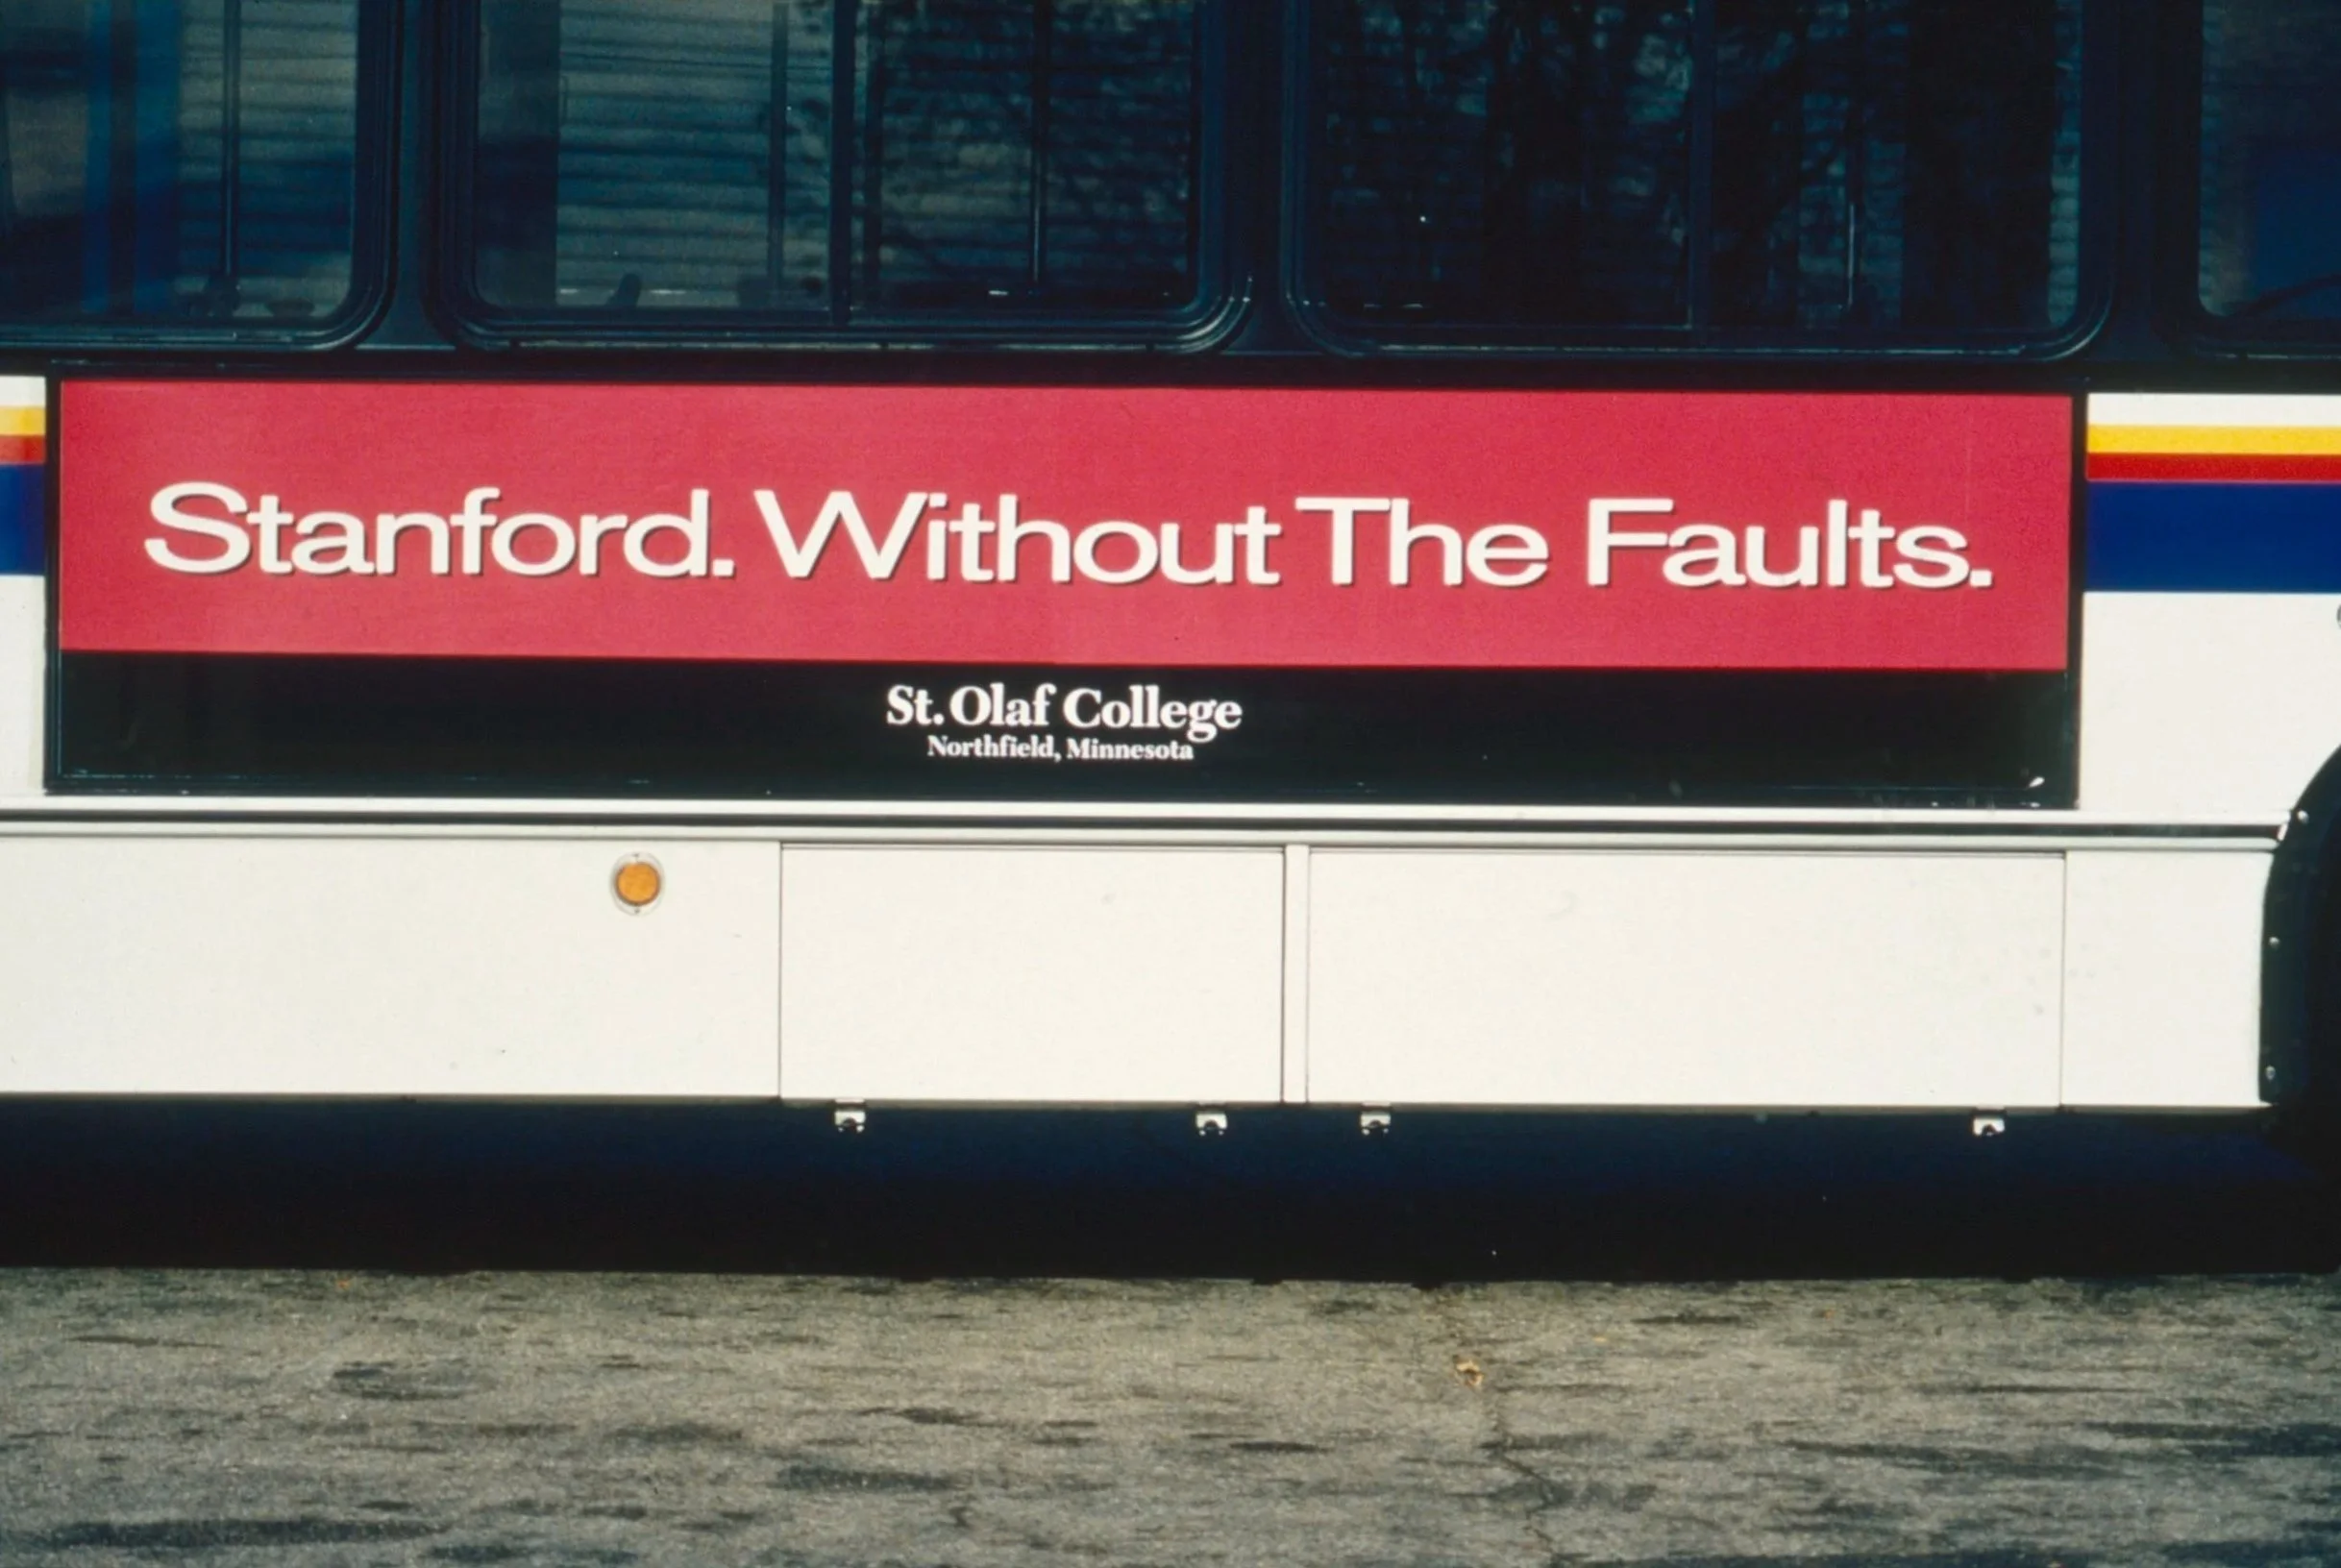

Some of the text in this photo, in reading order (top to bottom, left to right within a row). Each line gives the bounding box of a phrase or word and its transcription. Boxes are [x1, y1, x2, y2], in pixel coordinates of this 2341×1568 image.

[144, 480, 1994, 589] Stanford. Without The Faults.
[886, 681, 1244, 744] St. Olaf College
[926, 734, 1195, 762] Northfield, Minnesota
